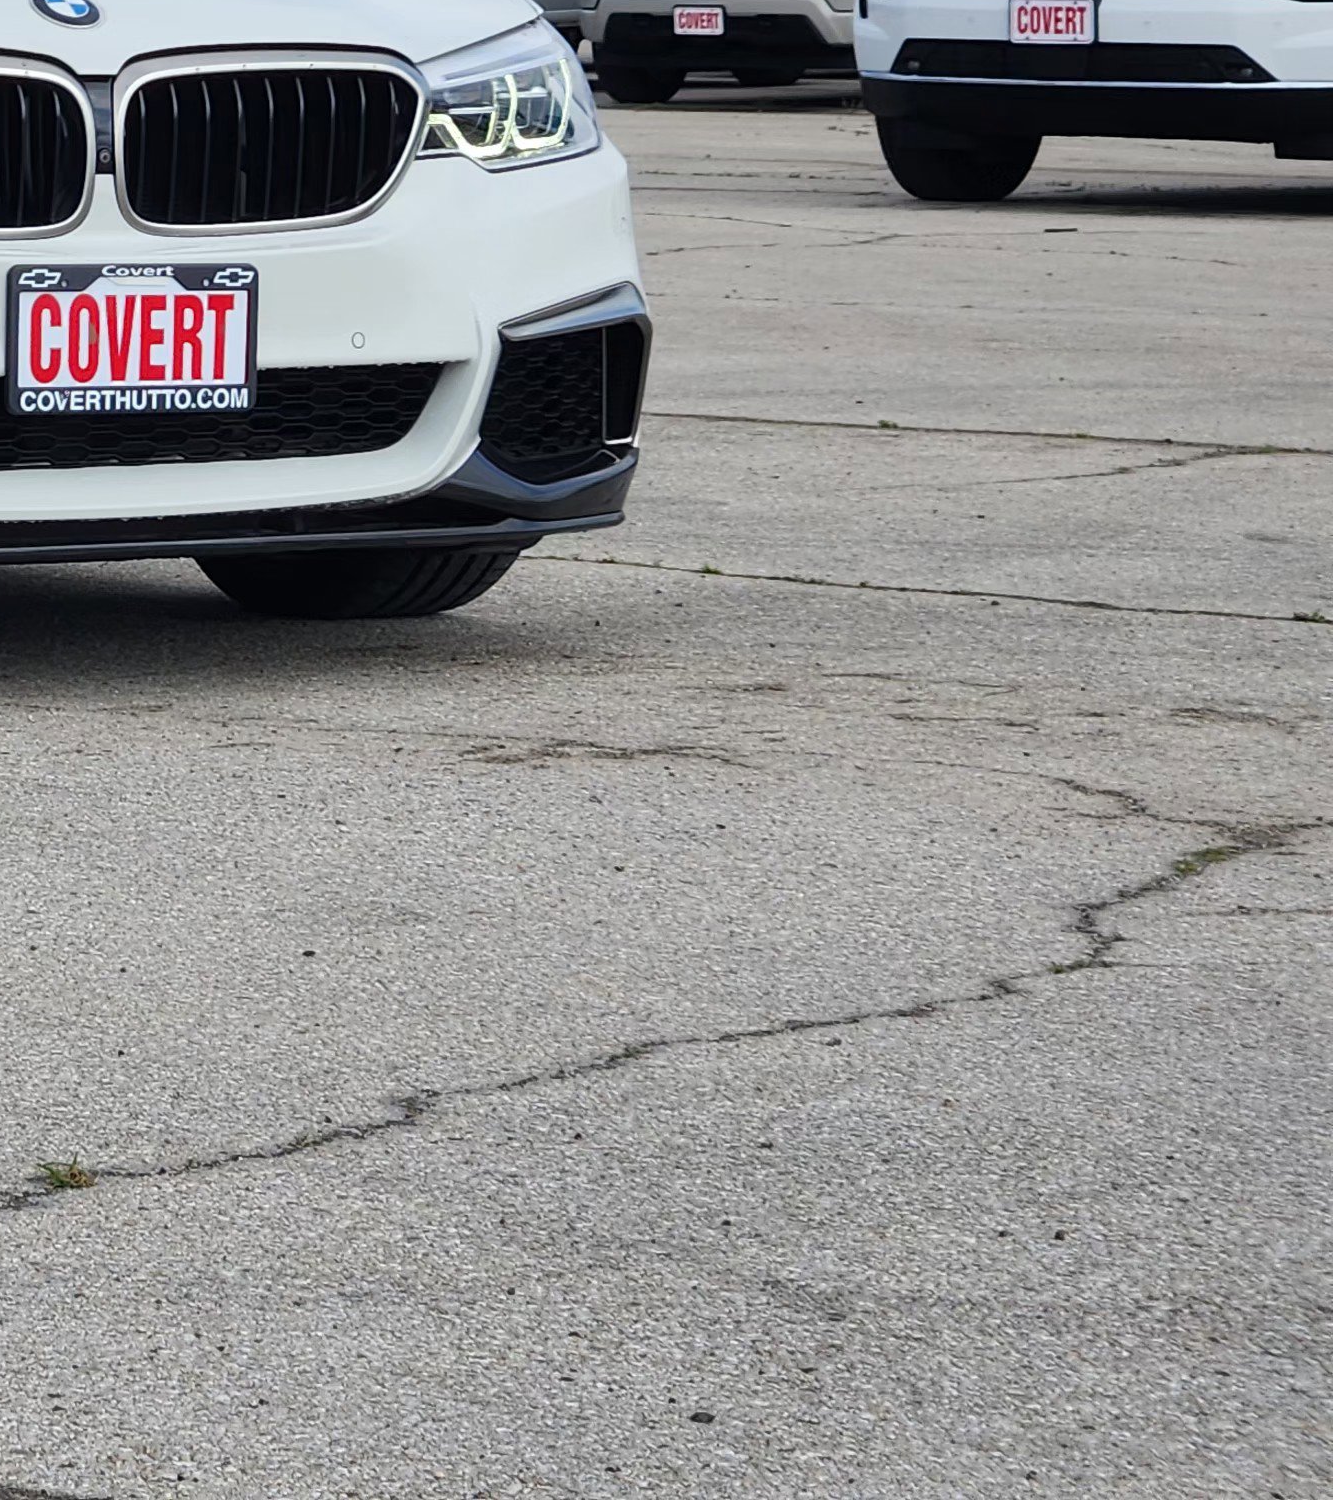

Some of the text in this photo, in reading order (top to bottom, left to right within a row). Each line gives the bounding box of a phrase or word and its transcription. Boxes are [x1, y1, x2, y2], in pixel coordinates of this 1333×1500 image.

[678, 12, 719, 29] COVERT
[1017, 5, 1087, 35] COVERT
[101, 265, 175, 277] Covert
[30, 293, 235, 384] COVERT
[19, 388, 249, 412] COVERTHUTTO.COM
